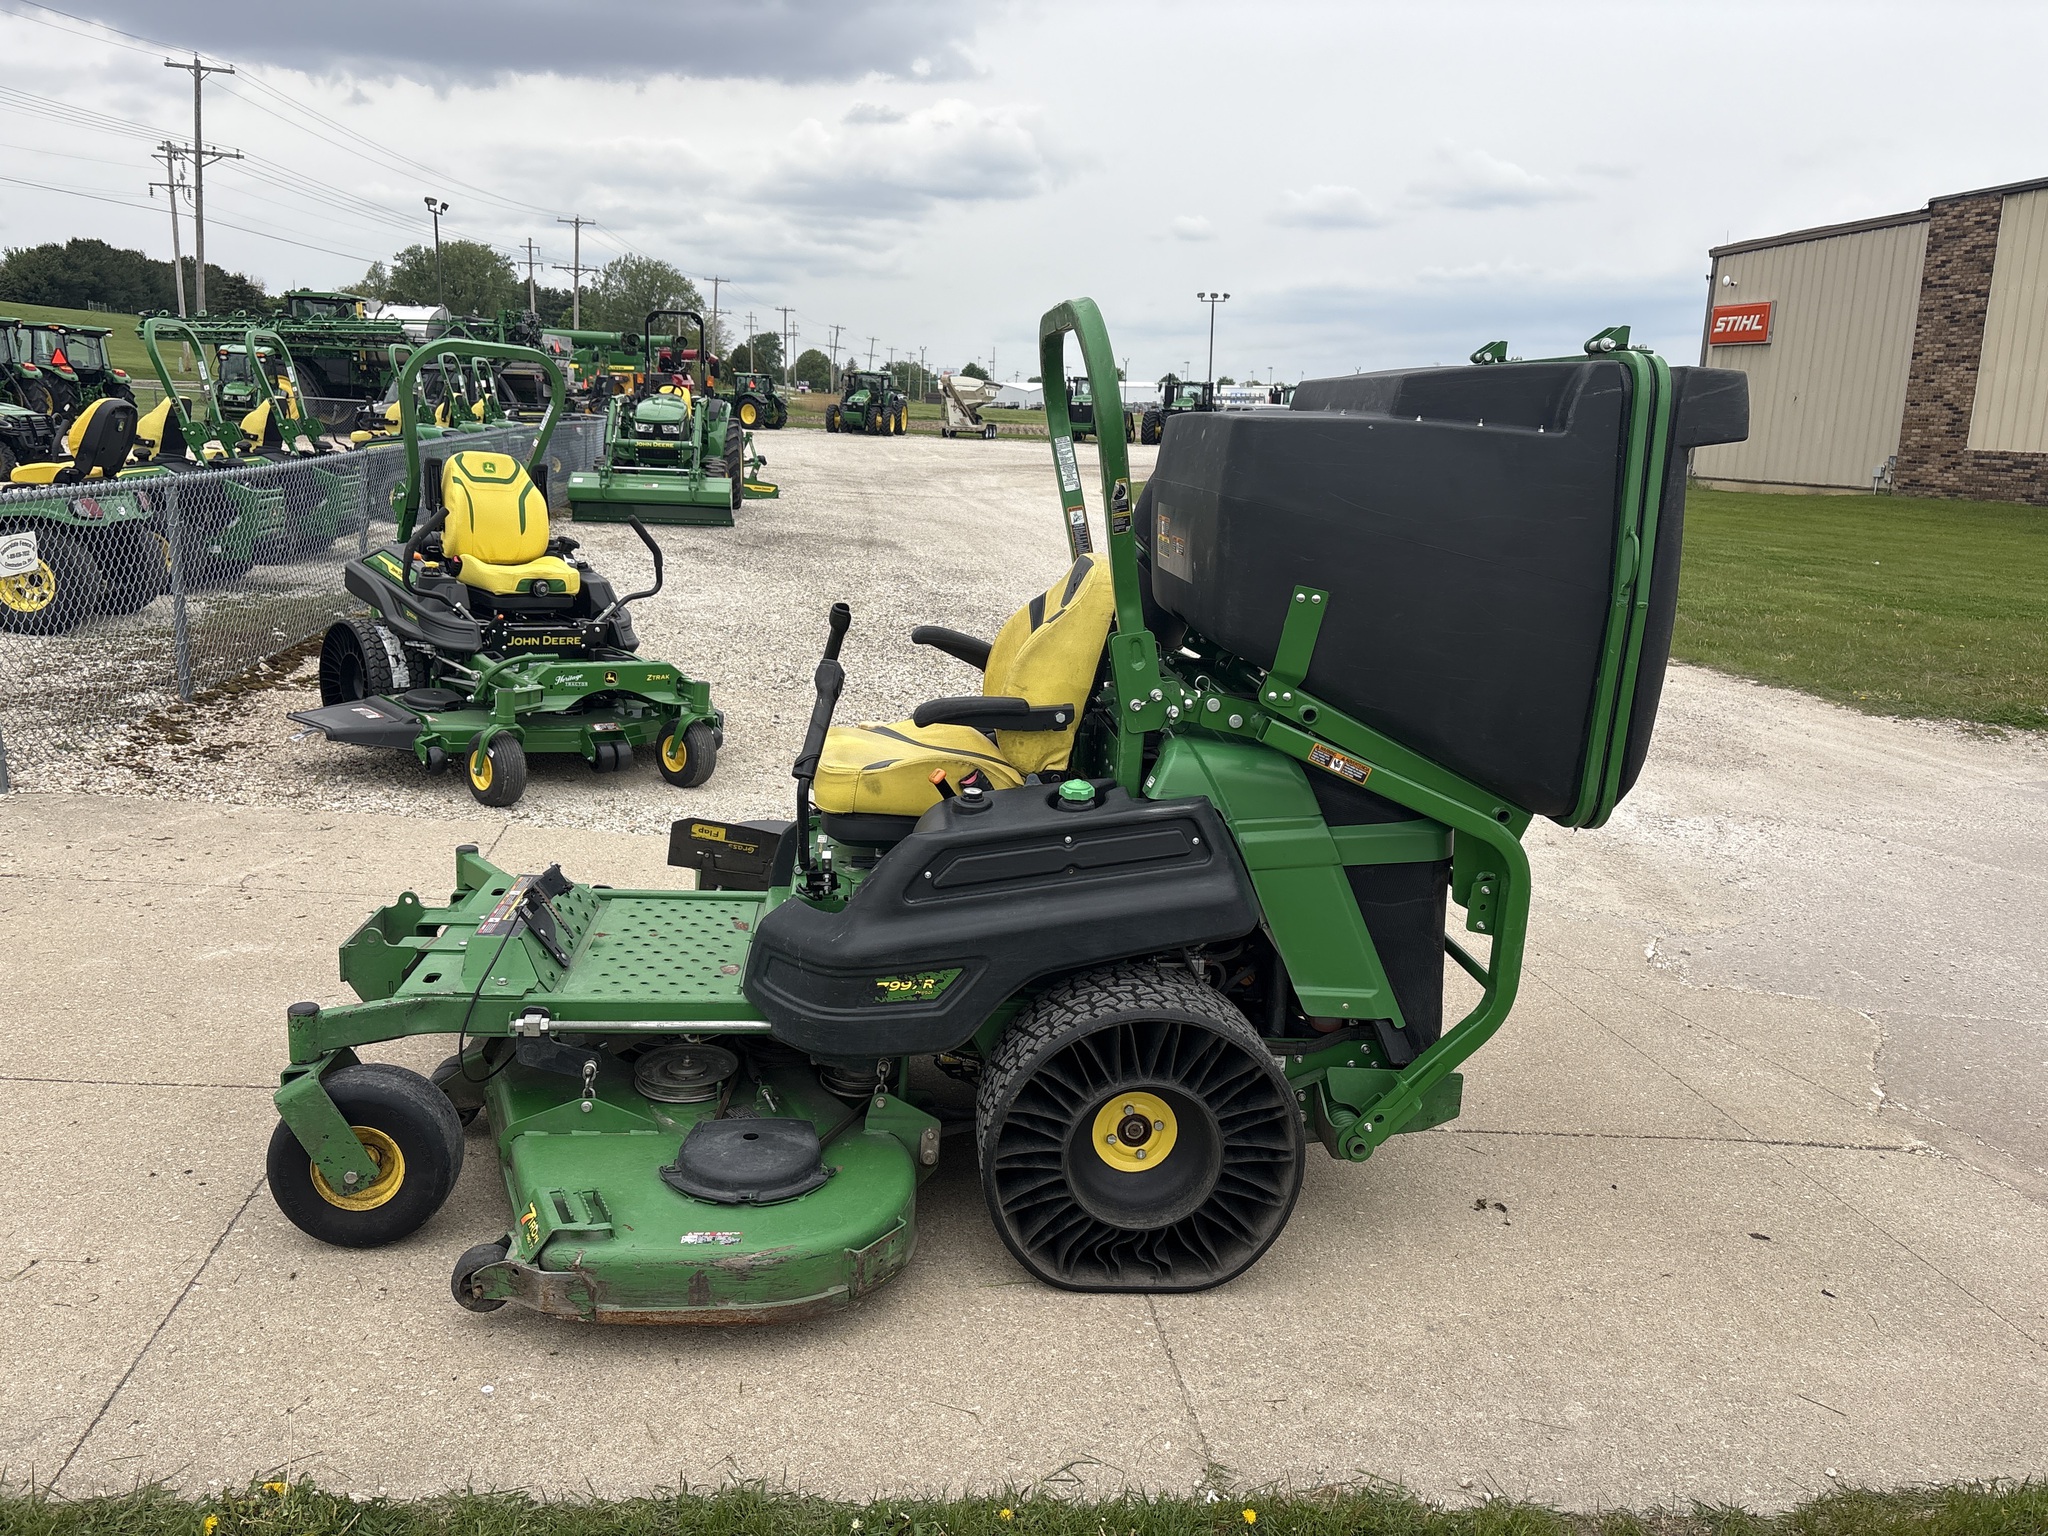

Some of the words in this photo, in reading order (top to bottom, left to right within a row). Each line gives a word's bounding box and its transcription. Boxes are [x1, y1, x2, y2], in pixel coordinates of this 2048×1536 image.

[1713, 314, 1763, 333] STIHL
[507, 636, 540, 646] JOHN
[542, 636, 582, 645] DEERE
[554, 674, 583, 685] Heritage
[646, 674, 670, 682] ZTRAK
[698, 827, 719, 838] Flap
